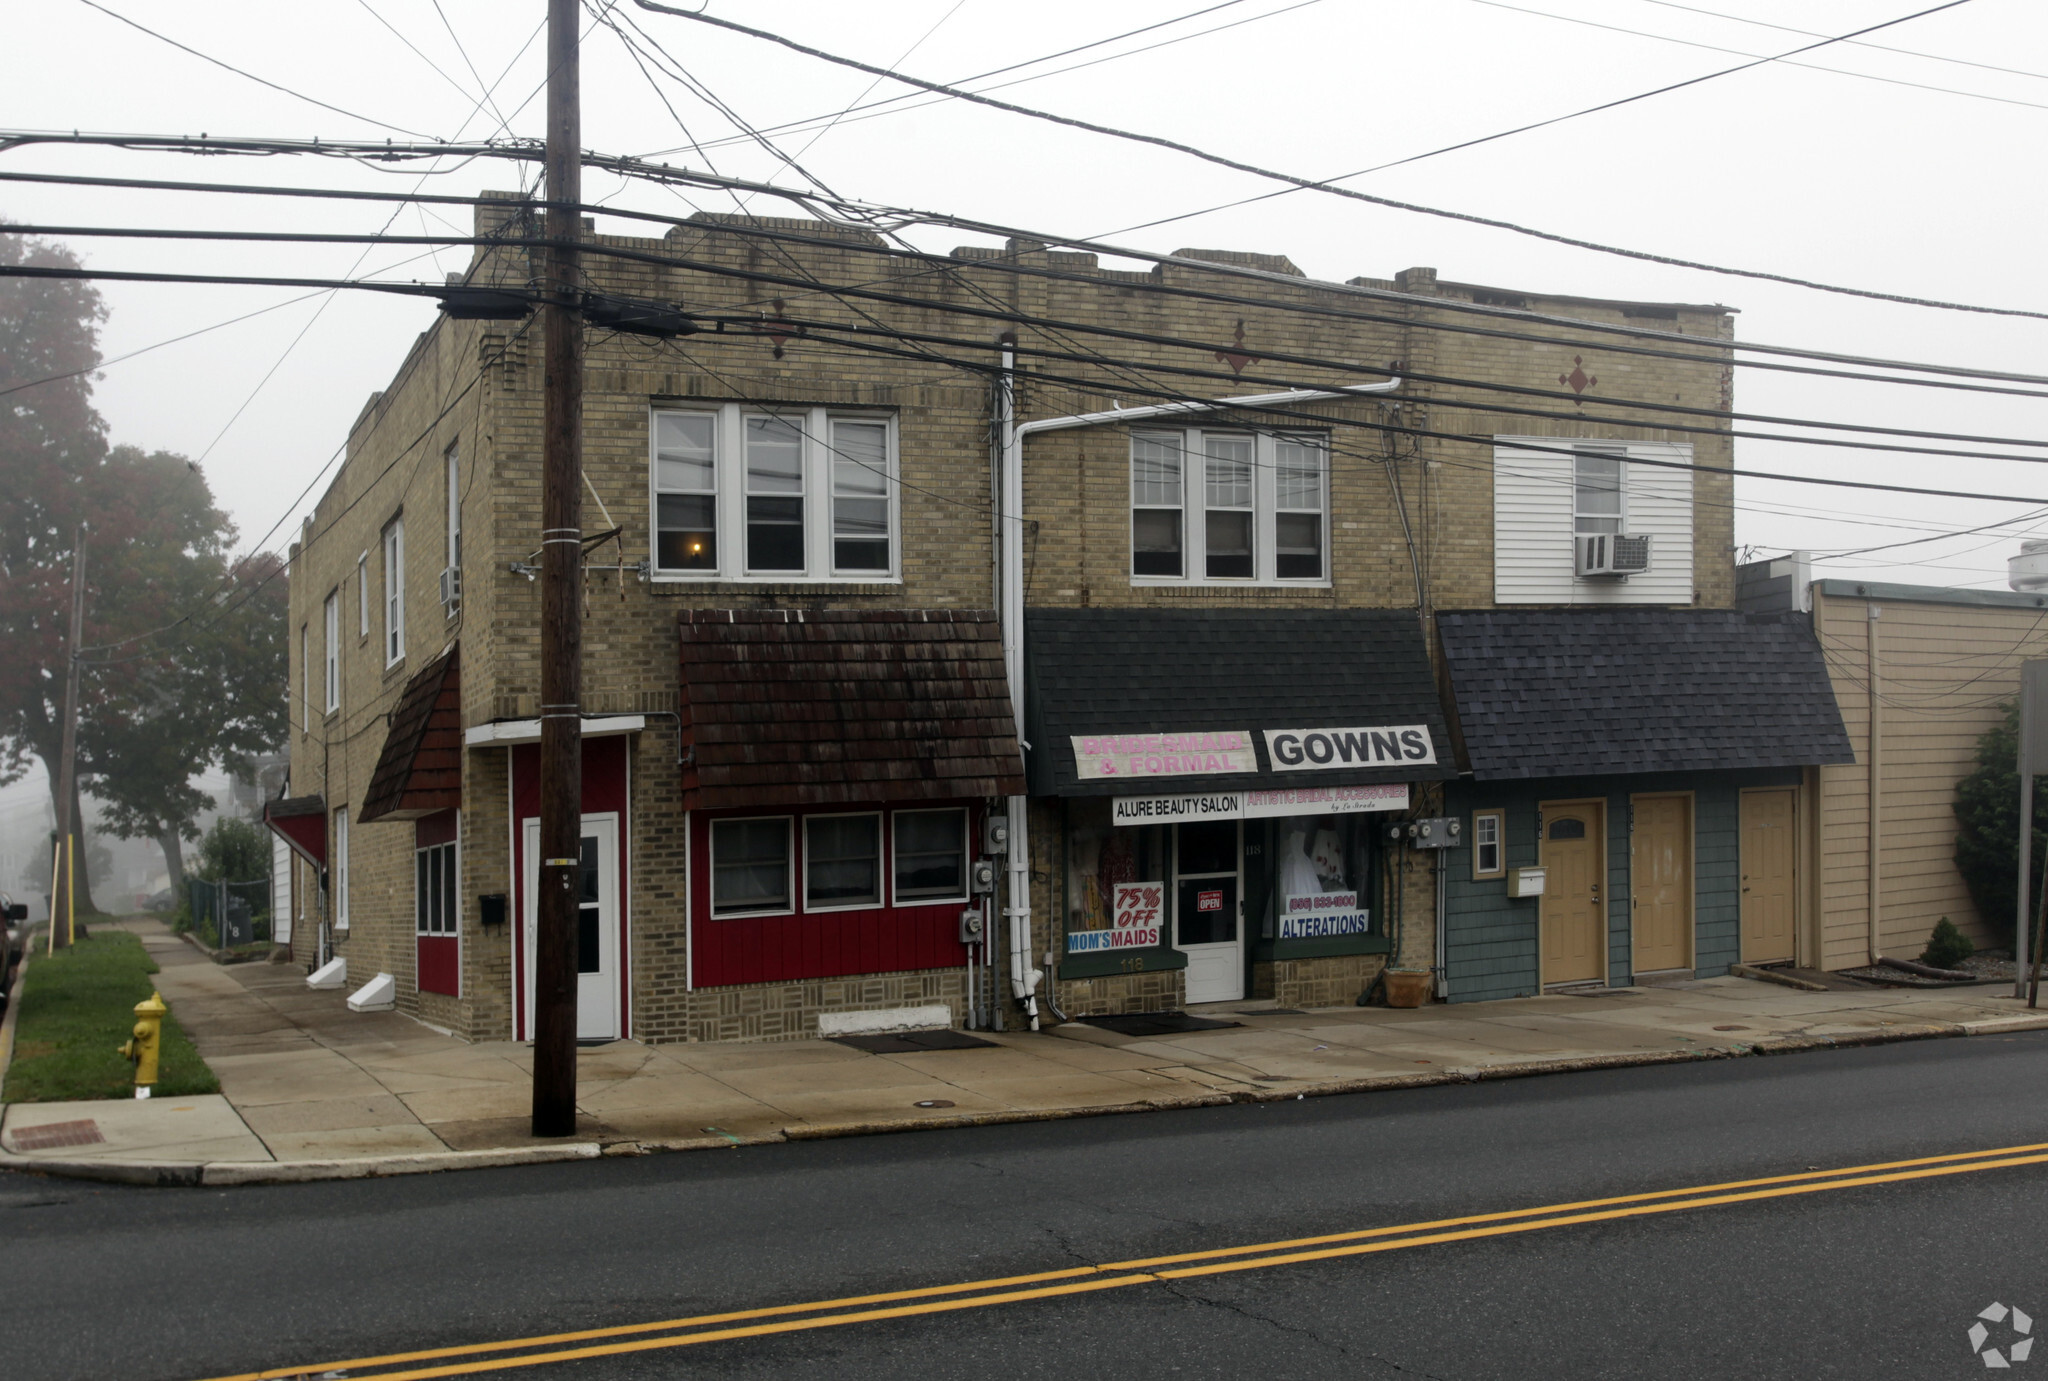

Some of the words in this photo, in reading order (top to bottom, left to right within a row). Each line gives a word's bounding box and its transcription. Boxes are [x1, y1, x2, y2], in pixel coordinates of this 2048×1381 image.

[1083, 734, 1243, 756] BRIDESMAID
[1274, 730, 1428, 765] GOWNS
[1101, 758, 1118, 775] &
[1130, 754, 1238, 774] FORMAL
[1247, 790, 1295, 806] ARTISTIC
[1297, 788, 1332, 804] BRIDAL
[1335, 783, 1407, 802] ACCESSORIES
[1117, 801, 1153, 818] ALURE
[1155, 798, 1200, 816] BEAUTY
[1201, 796, 1238, 813] SALON
[1331, 803, 1339, 812] by
[1116, 887, 1162, 909] 75%
[1200, 898, 1221, 910] OPEN
[1118, 909, 1159, 928] OFF
[1282, 913, 1366, 938] ALTERATIONS
[1068, 931, 1111, 951] MOM'S
[1111, 928, 1158, 947] MAIDS
[1120, 957, 1144, 973] 118
